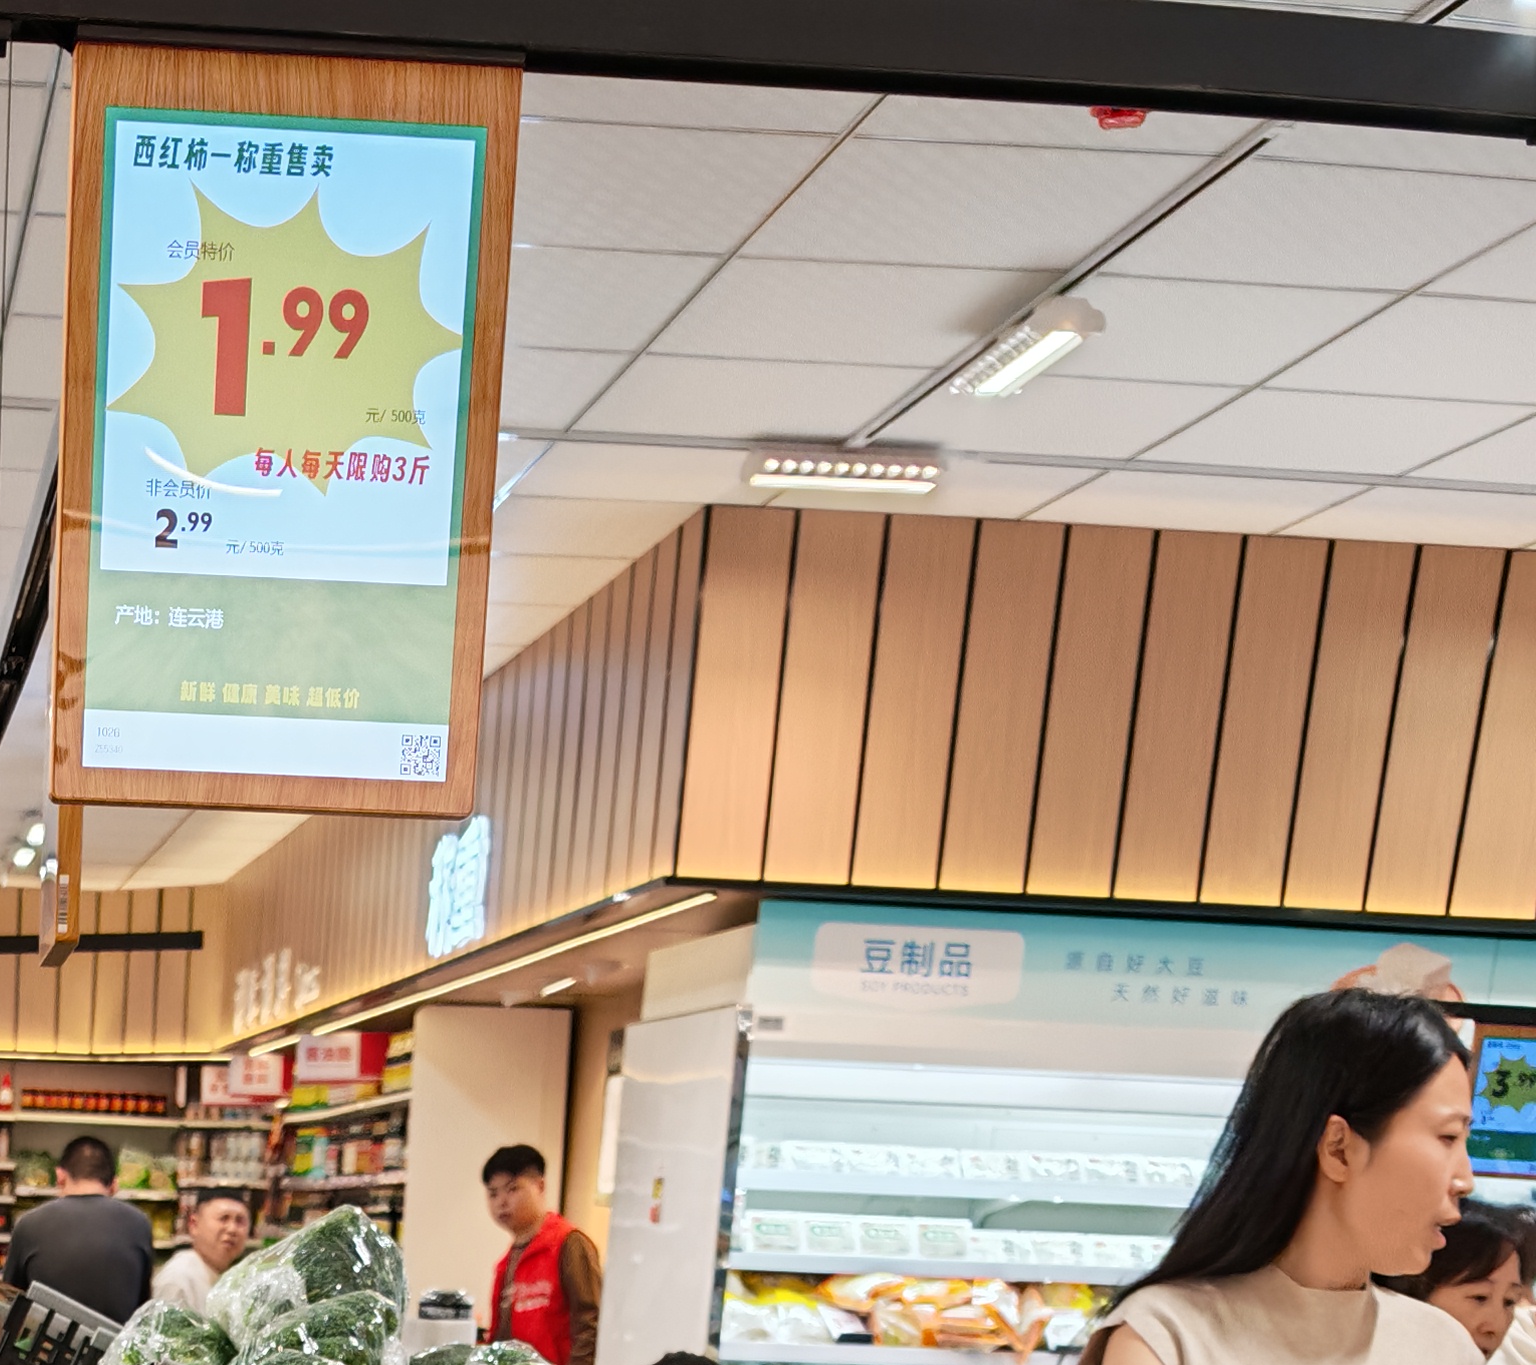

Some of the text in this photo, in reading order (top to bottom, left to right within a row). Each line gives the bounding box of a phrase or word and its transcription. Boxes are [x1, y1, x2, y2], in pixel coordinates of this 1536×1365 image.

[166, 240, 235, 262] 会员特价
[202, 277, 370, 417] 1.99
[254, 447, 430, 486] 每人每天限购3斤
[146, 478, 212, 500] 非会员价
[154, 508, 213, 549] 2.99
[306, 686, 360, 709] 超低价
[861, 938, 972, 978] 豆制品
